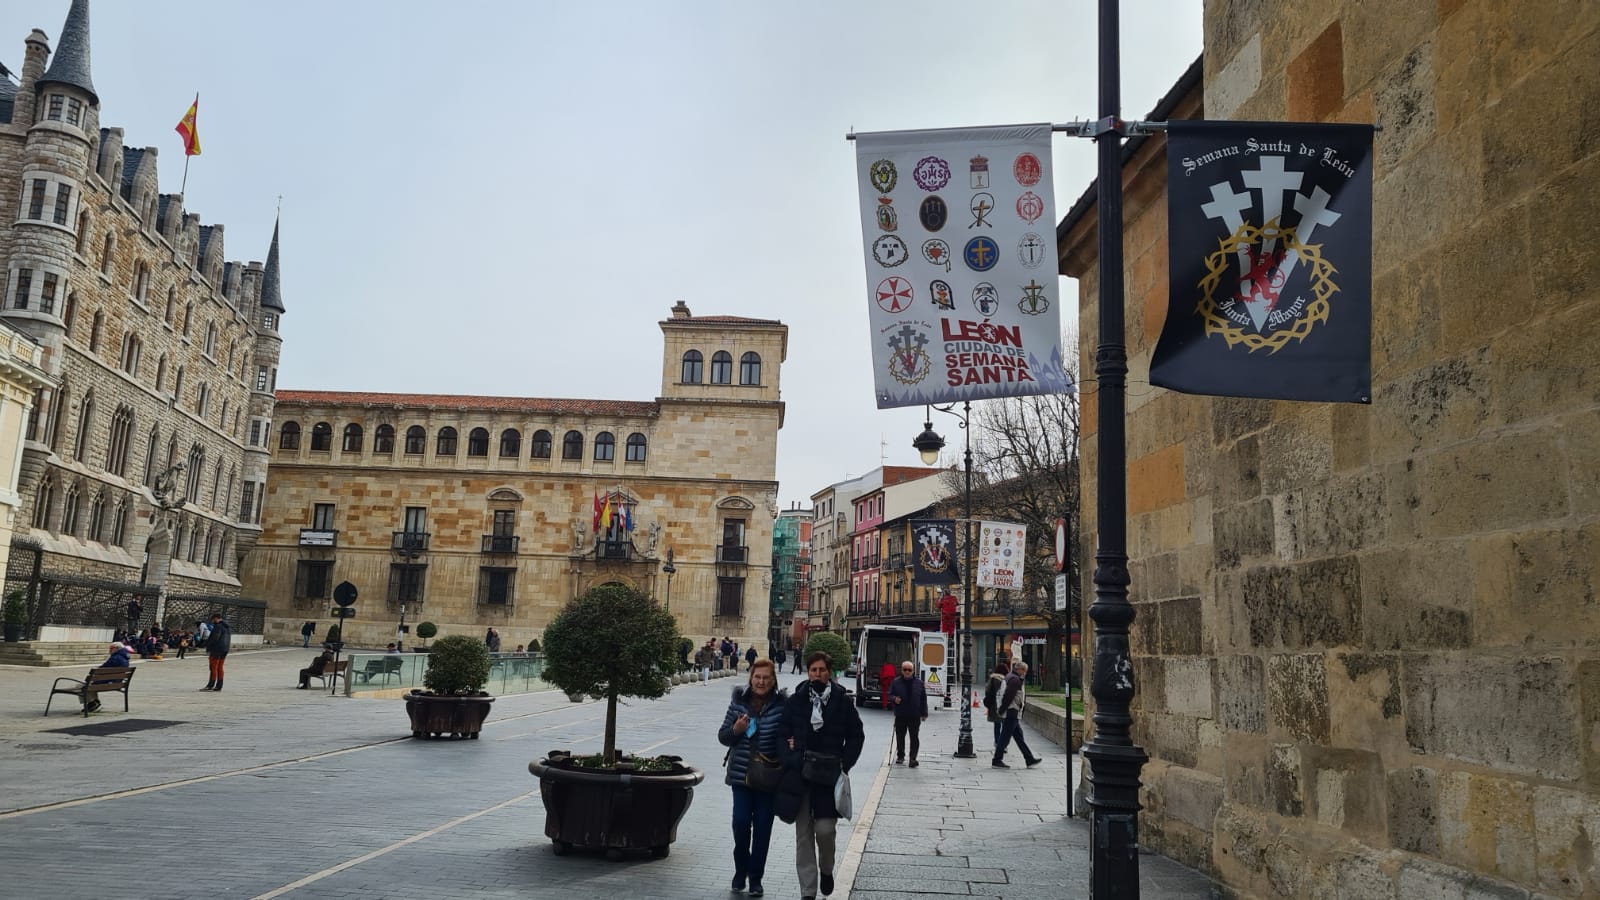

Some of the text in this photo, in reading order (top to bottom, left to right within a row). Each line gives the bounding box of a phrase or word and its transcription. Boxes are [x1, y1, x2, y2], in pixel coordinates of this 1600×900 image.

[1182, 137, 1355, 178] Semana Santa de León
[1220, 295, 1306, 331] Junta Mayor
[941, 318, 1023, 348] LEÓN
[944, 342, 1026, 358] CIUDAD DE
[945, 352, 1030, 369] SEMANA
[947, 366, 1036, 387] SANTA
